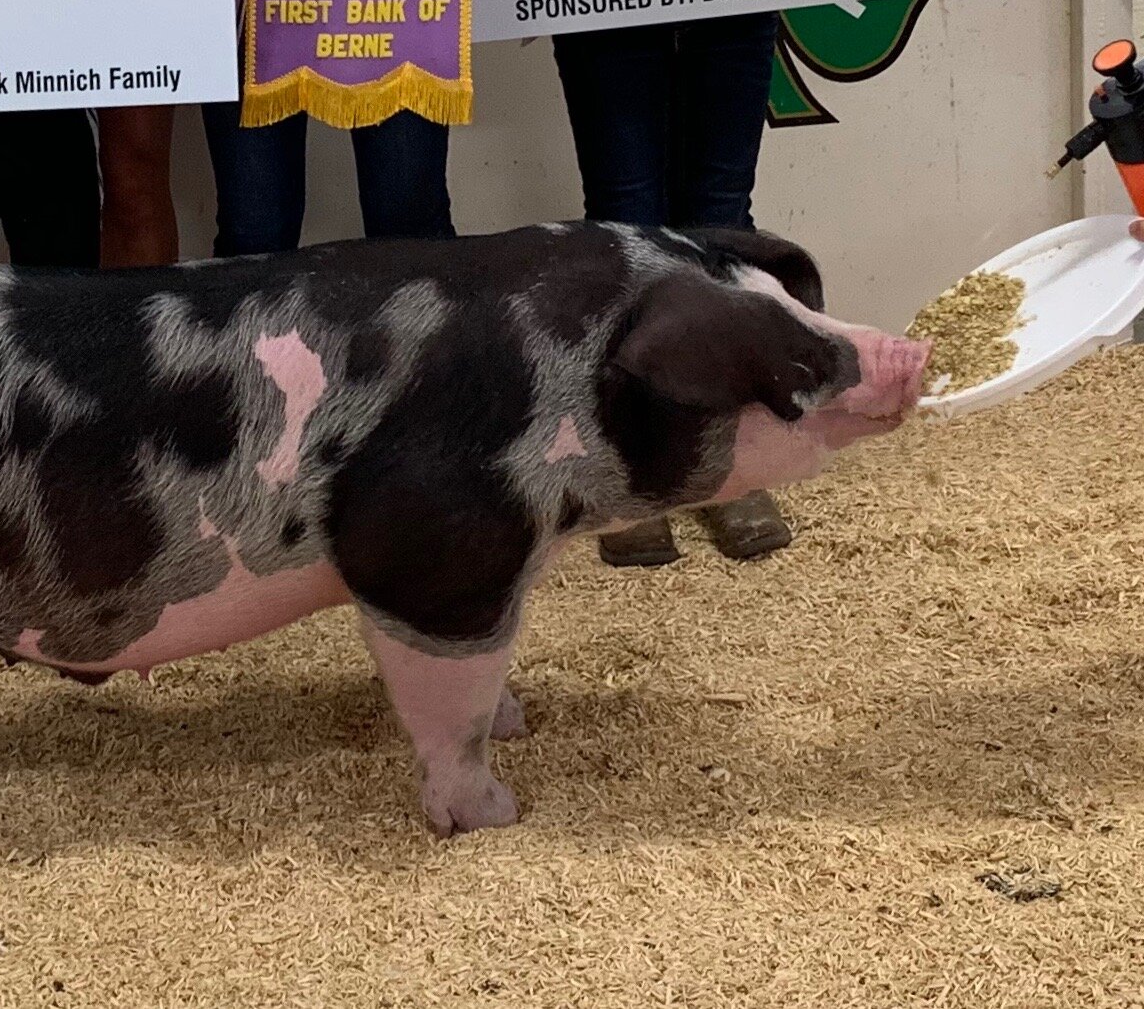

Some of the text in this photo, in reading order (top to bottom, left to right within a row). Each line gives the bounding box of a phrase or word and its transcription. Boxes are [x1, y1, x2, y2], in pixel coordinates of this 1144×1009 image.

[264, 0, 333, 24] FIRST
[316, 33, 394, 58] BERNE
[16, 68, 101, 94] Minnich
[109, 65, 182, 92] Family
